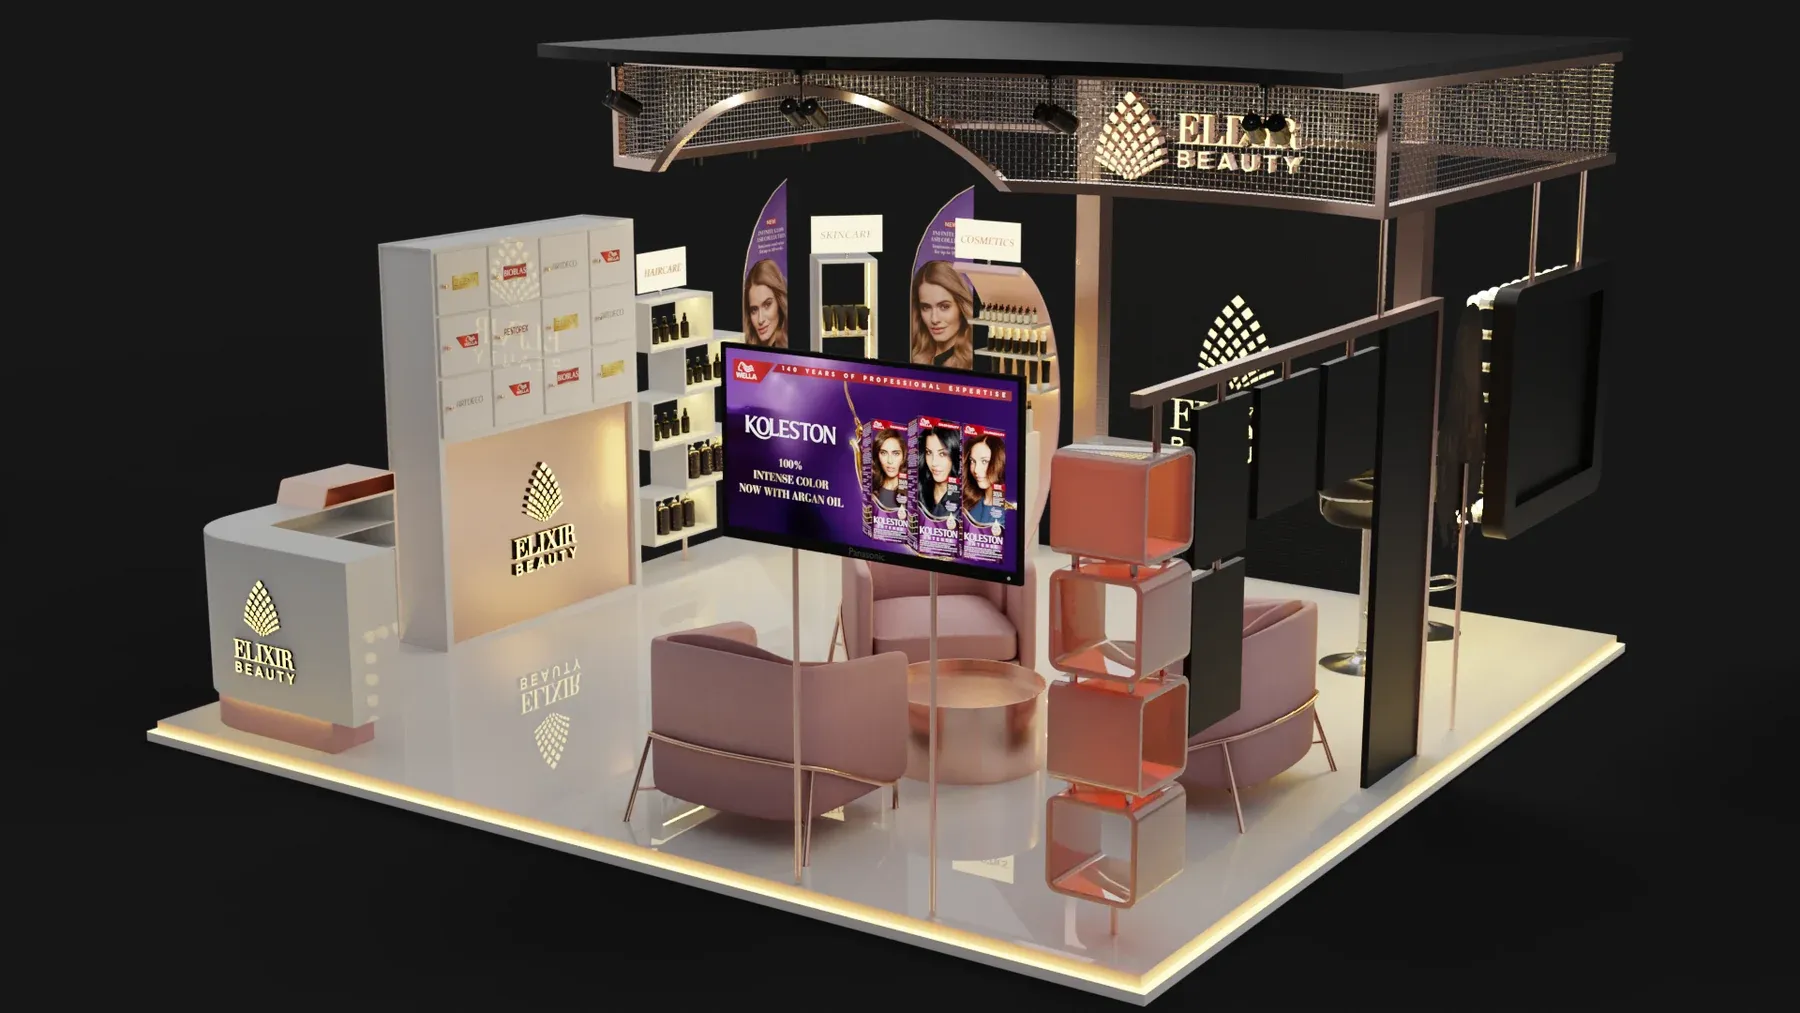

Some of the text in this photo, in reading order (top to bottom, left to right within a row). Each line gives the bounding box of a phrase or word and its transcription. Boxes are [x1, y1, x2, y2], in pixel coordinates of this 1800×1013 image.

[1177, 150, 1304, 175] BEAUTY
[820, 230, 872, 240] SKINCARE
[960, 234, 1015, 248] COSMETICS
[504, 266, 527, 278] BIOBLAS
[644, 262, 683, 278] HAIRCARE
[735, 371, 758, 381] WELLA
[781, 365, 798, 373] 140
[805, 368, 836, 378] YEARS
[863, 374, 941, 391] PROFESSIONAL
[948, 385, 1007, 399] EXPERTISE
[745, 414, 836, 446] KOLESTON
[779, 458, 803, 471] 100%
[753, 469, 829, 491] INTENSE COLOR
[739, 482, 844, 508] NOW WITH ARGAN OIL
[873, 515, 909, 528] KOLESTON
[919, 525, 958, 539] KOLESTON
[964, 531, 1004, 545] KOLESTON
[512, 523, 578, 560] ELIXIR
[512, 546, 577, 577] BEAUTY
[848, 547, 887, 561] Panasonic
[233, 638, 296, 672] ELIXIR
[235, 660, 296, 686] BEAUTY
